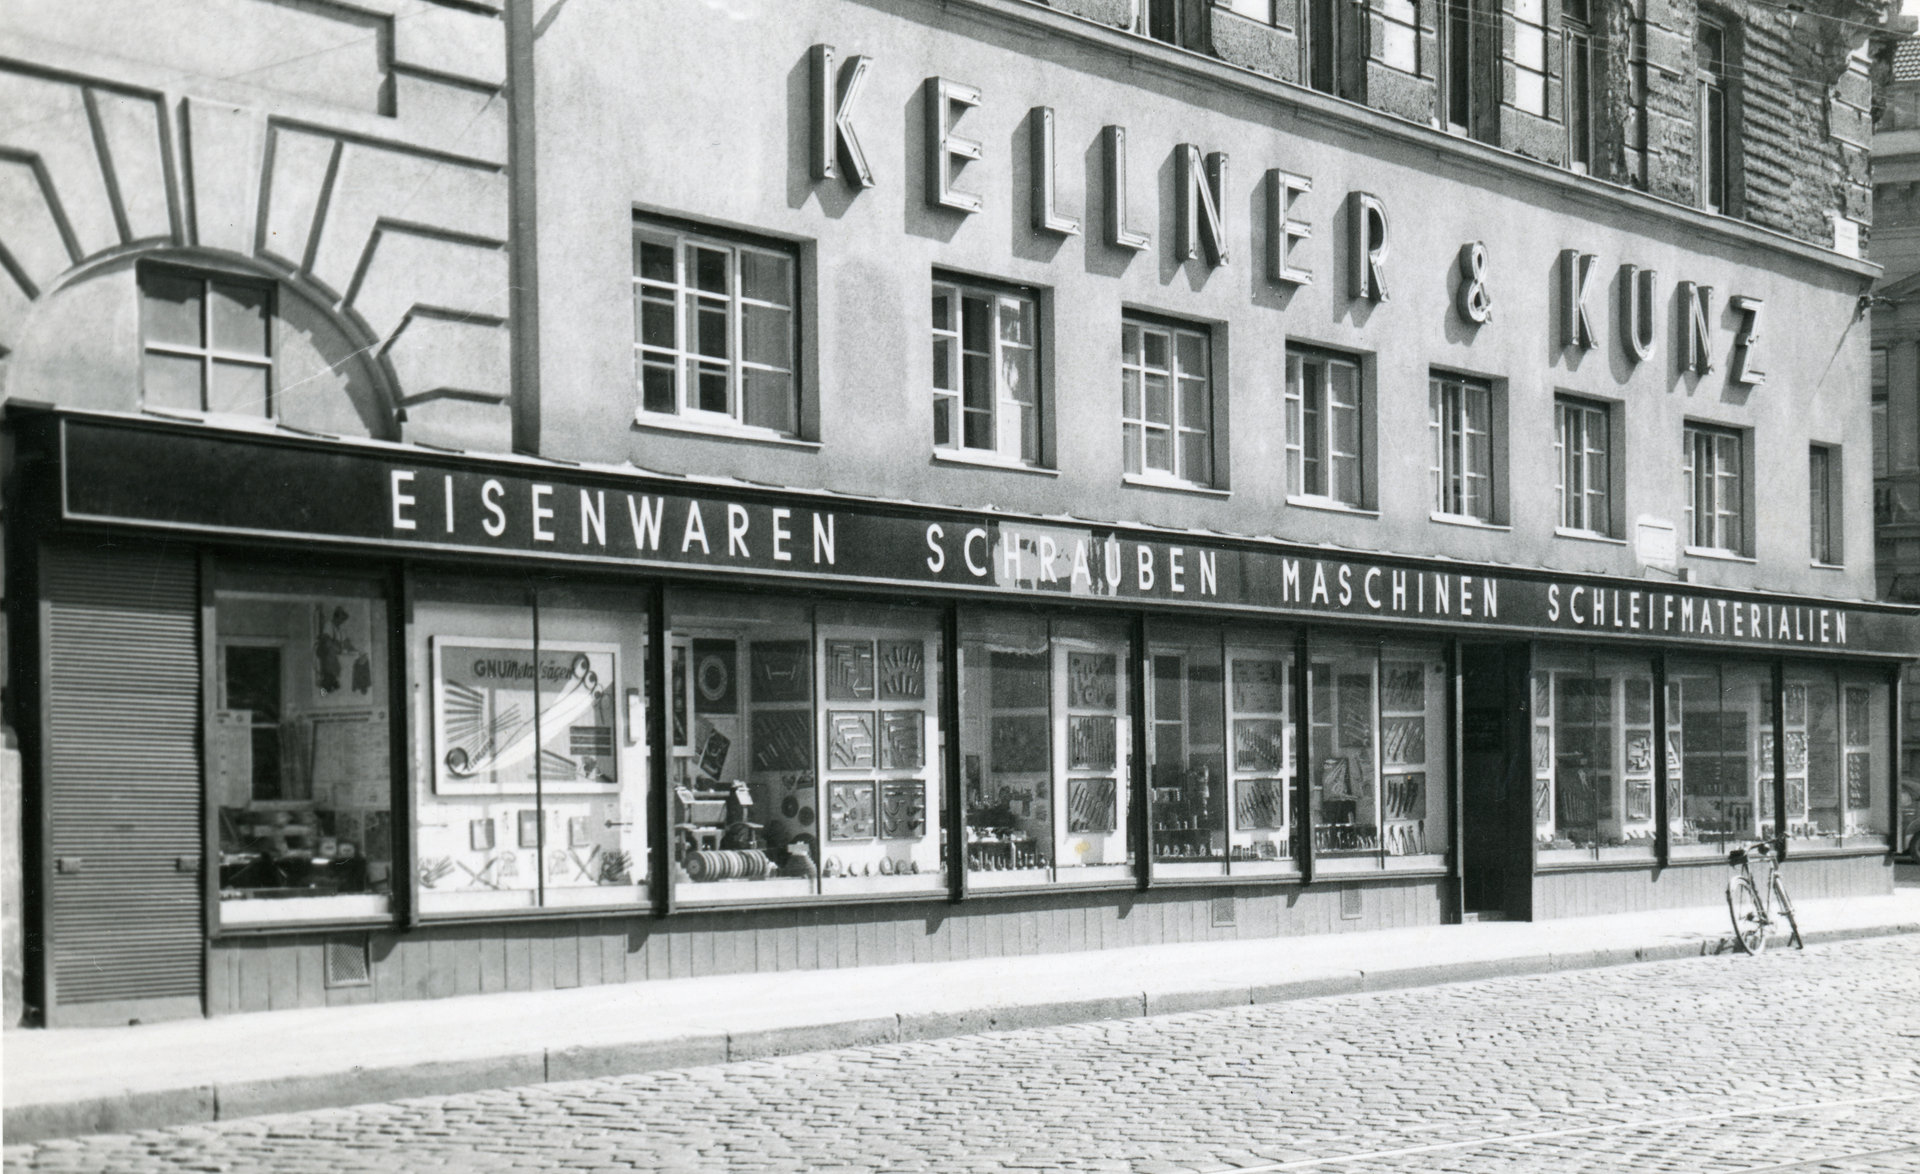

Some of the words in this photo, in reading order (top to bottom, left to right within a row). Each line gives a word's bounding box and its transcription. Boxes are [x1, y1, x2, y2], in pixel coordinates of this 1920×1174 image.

[810, 43, 1391, 302] KELLNER
[1456, 240, 1493, 325] &
[1560, 249, 1766, 385] KUNZ
[391, 470, 835, 565] EISENWAREN
[926, 523, 1217, 596] SCHRAUBEN
[1283, 558, 1497, 618] MASCHINEN
[1548, 584, 1847, 644] SCHLEIFMATERIALIEN
